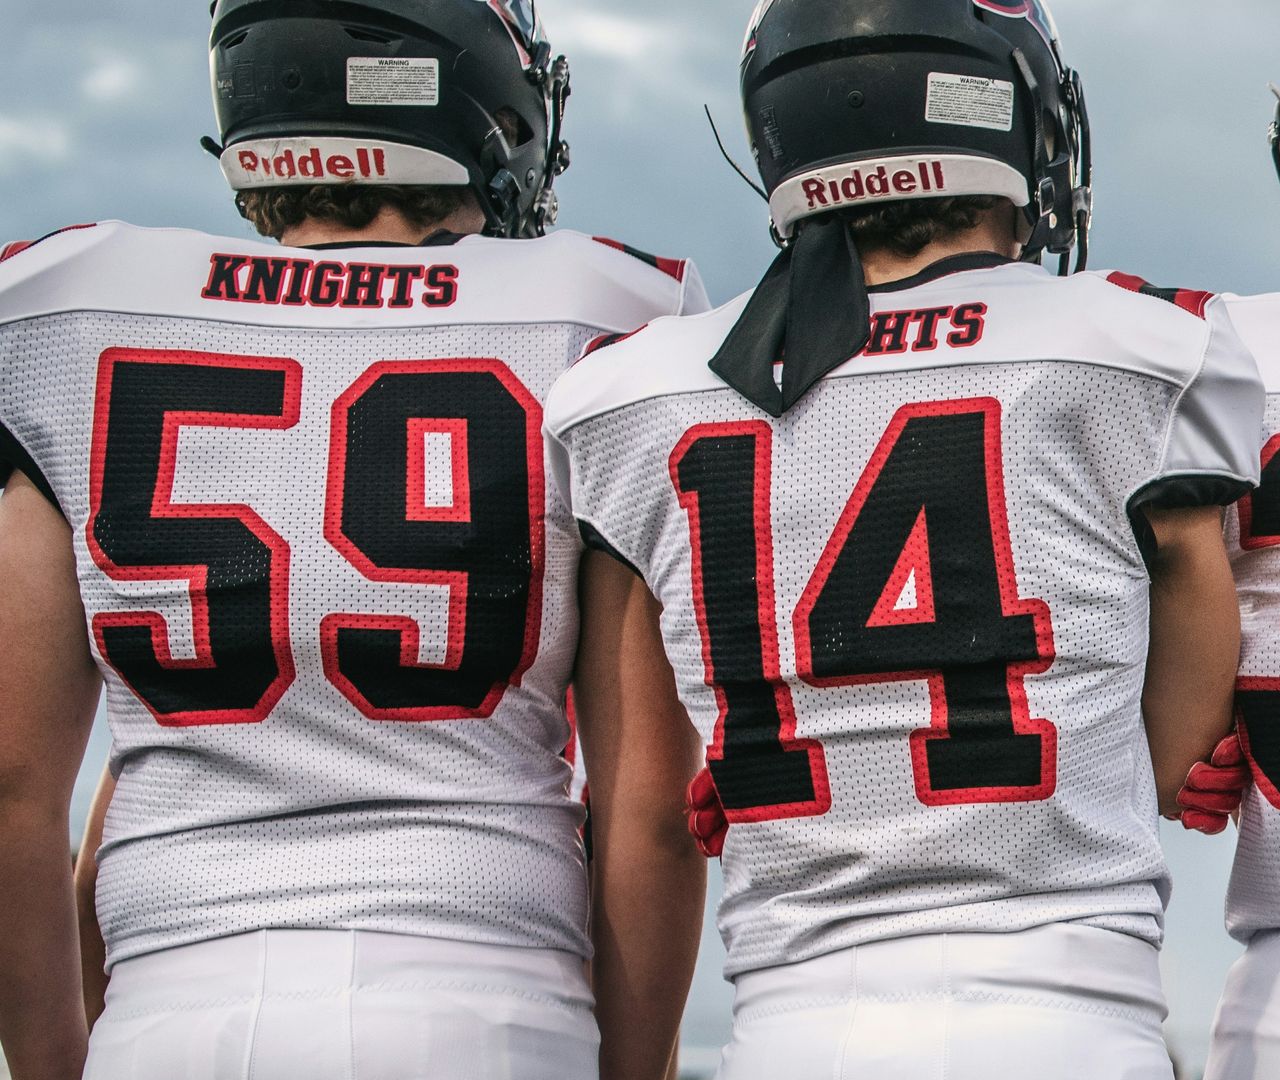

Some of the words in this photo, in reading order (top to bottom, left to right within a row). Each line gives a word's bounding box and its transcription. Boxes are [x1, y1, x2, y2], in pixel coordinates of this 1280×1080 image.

[238, 147, 386, 178] Riddell
[802, 161, 946, 207] Riddell
[201, 253, 459, 309] KNIGHTS
[86, 346, 545, 727] 59
[668, 396, 1057, 822] 14
